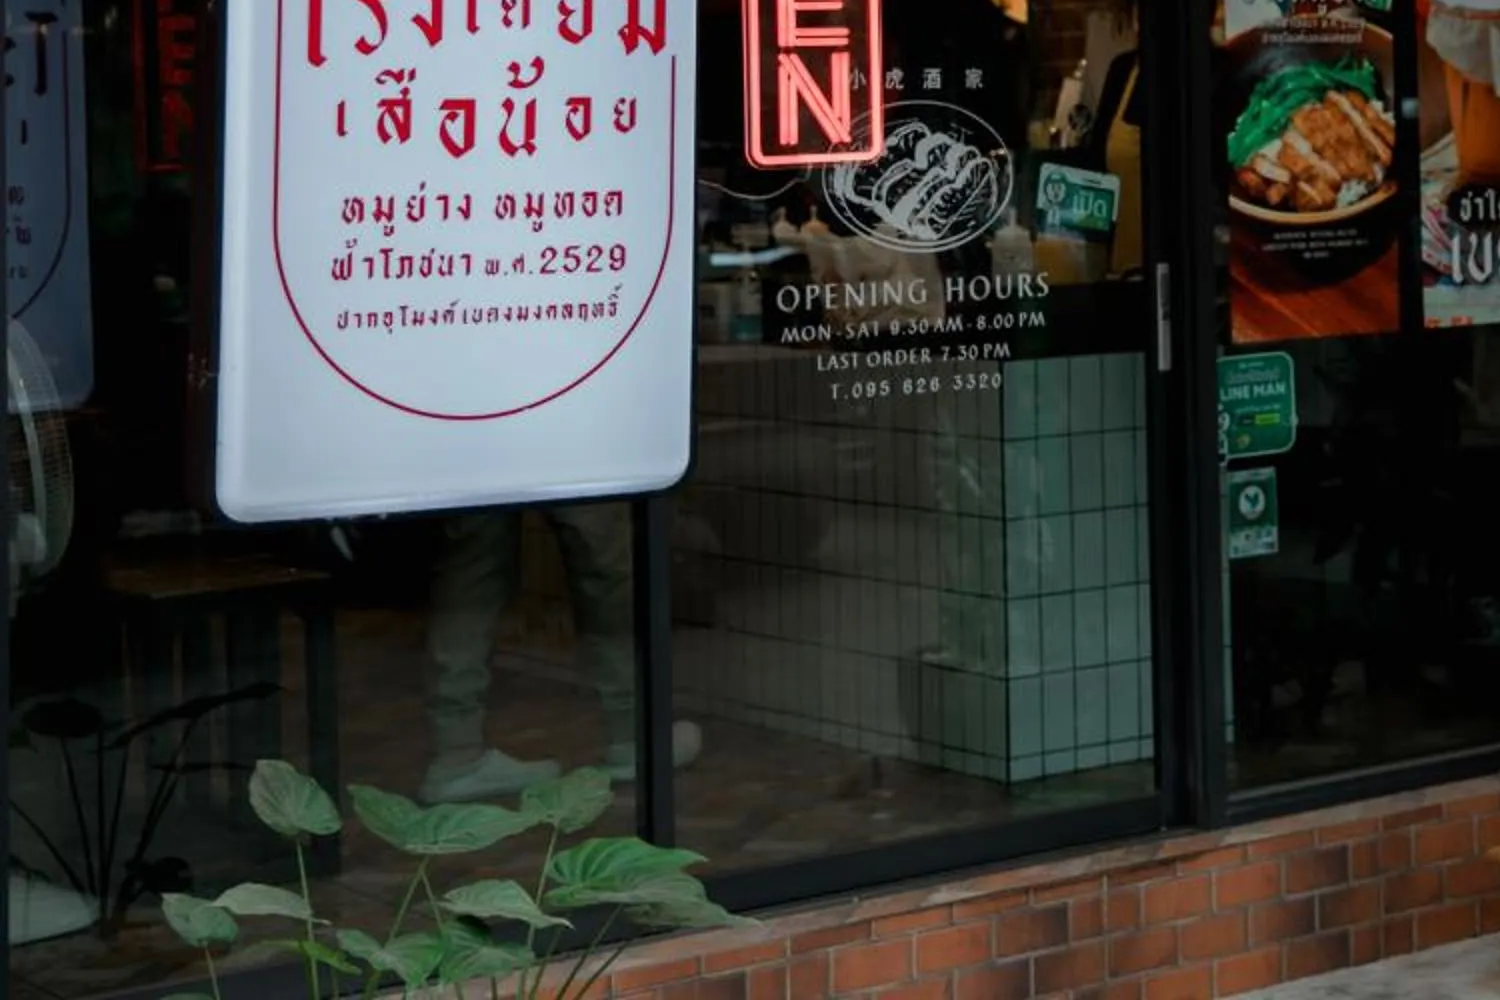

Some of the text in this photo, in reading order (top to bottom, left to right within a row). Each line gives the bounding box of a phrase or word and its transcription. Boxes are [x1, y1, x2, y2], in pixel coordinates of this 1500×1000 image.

[335, 56, 637, 159] เสือน้อย
[341, 181, 624, 236] หมูย่าง หมูทอด
[331, 238, 472, 281] ฟ้าโภชนา
[776, 271, 1050, 313] OPENING HOURS
[1019, 311, 1046, 328] PM
[817, 352, 859, 372] LAST
[866, 348, 932, 368] ORDER
[984, 342, 1012, 359] PM
